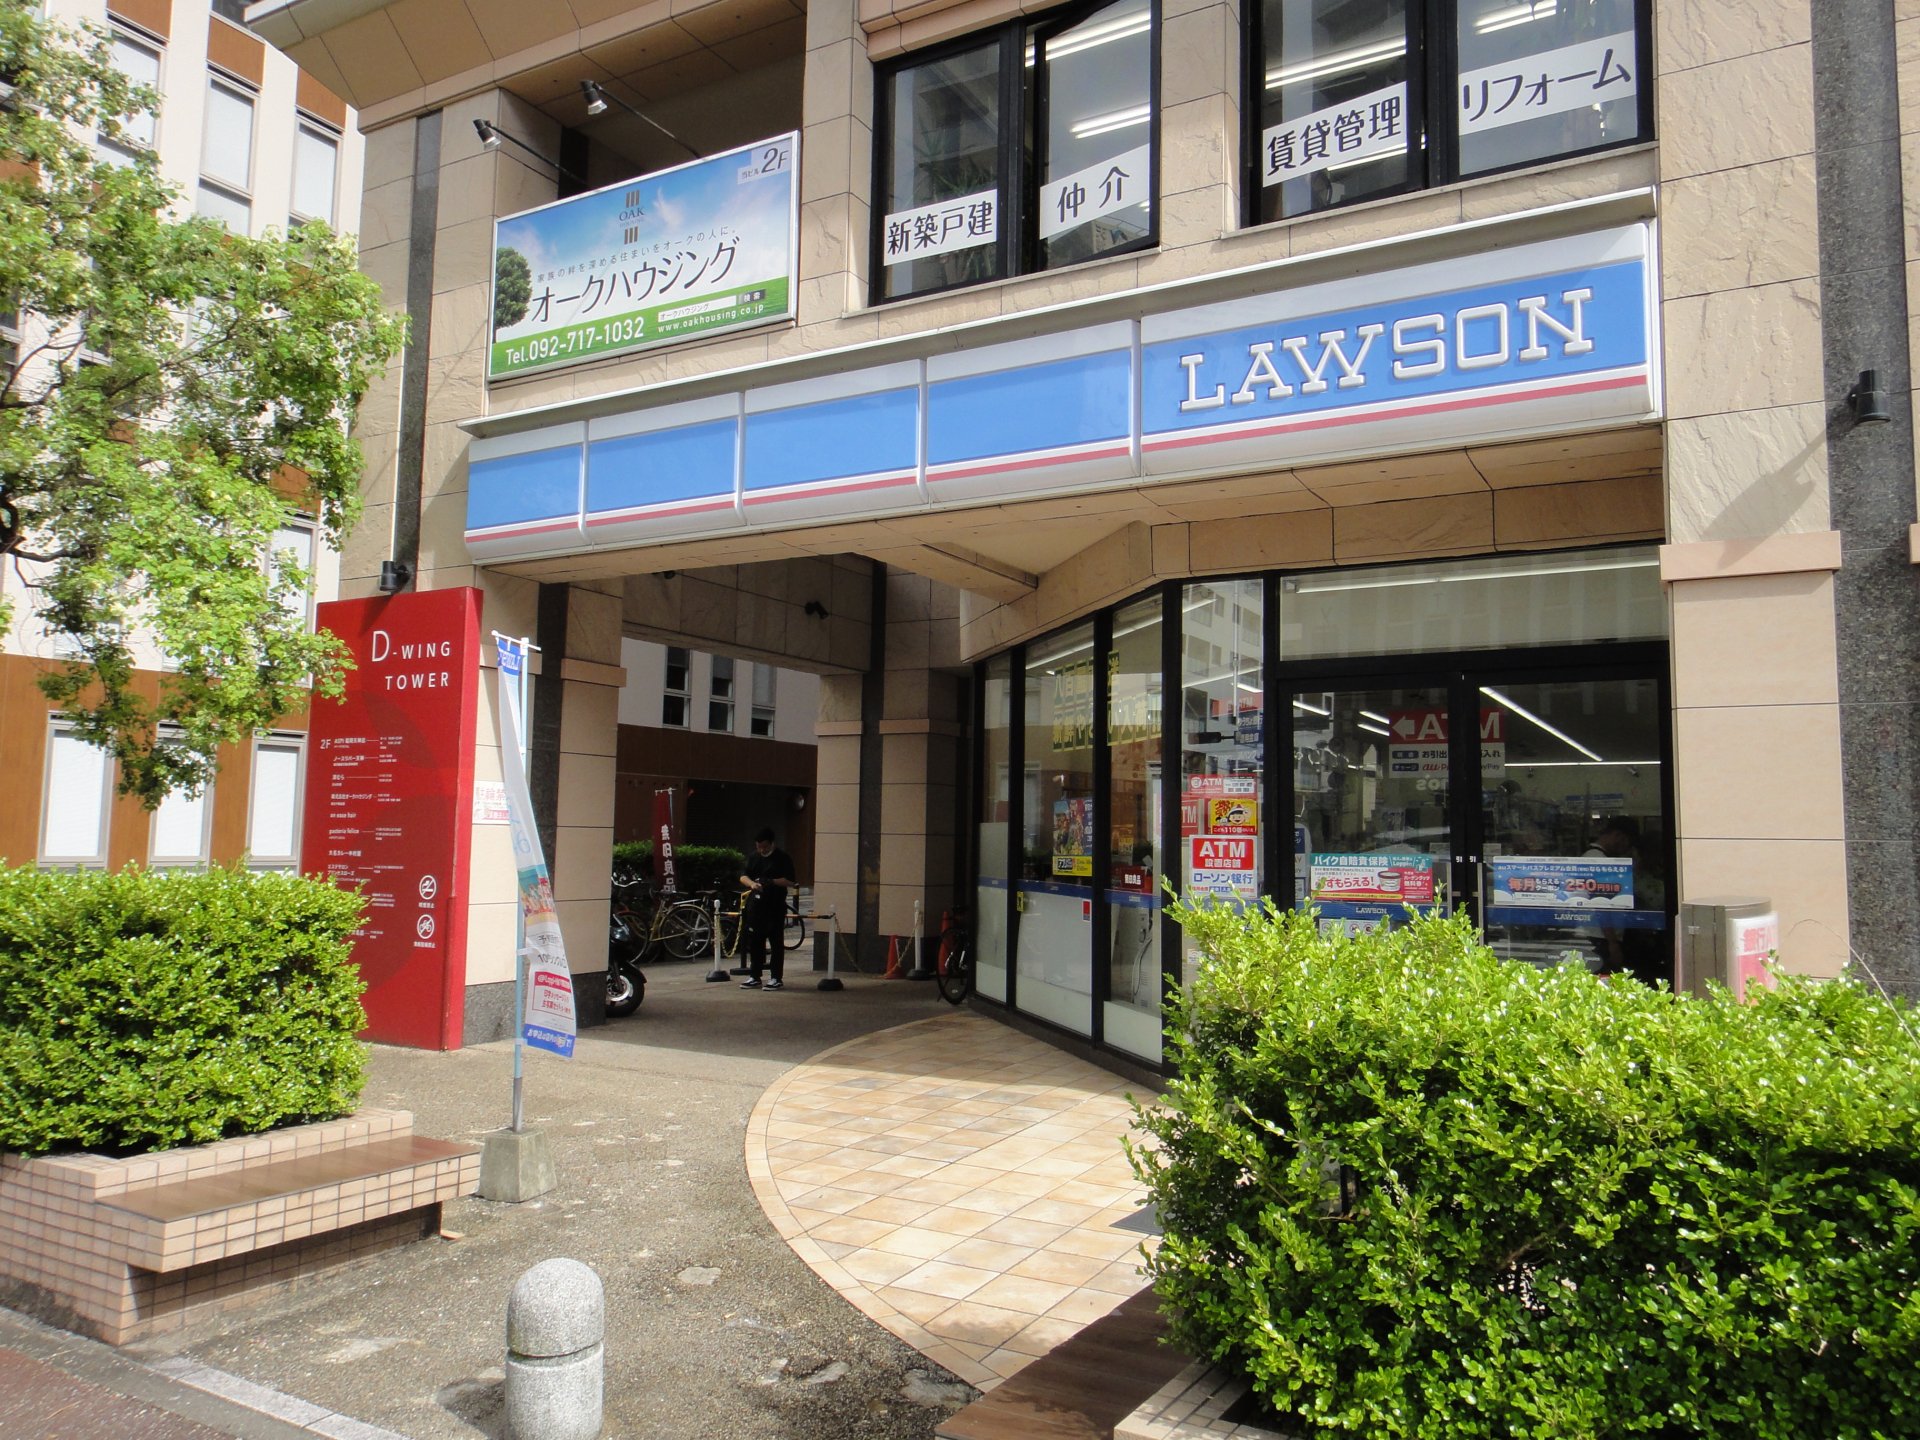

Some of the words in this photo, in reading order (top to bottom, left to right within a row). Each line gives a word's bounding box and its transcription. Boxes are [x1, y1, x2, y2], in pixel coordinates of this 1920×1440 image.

[1462, 48, 1631, 122] リフォーム
[1266, 95, 1401, 176] 賃貸管理
[761, 147, 789, 174] 2F
[1056, 165, 1130, 223] 仲介
[618, 206, 646, 222] OAK
[887, 200, 993, 255] 新築戸建
[532, 236, 740, 322] オークハウジング
[658, 303, 765, 333] www.oakhousing.co.jp
[660, 302, 709, 320] オークハウジング
[1178, 287, 1595, 413] LAWSON
[385, 672, 449, 690] TOWER
[320, 739, 331, 749] 2F
[1202, 777, 1222, 786] ATM
[1199, 841, 1246, 858] ATM
[1204, 858, 1242, 868] 設置店舗
[1314, 855, 1389, 867] バイク自賠責保険
[1193, 872, 1253, 884] ローソン銀行
[1508, 877, 1535, 892] 毎月
